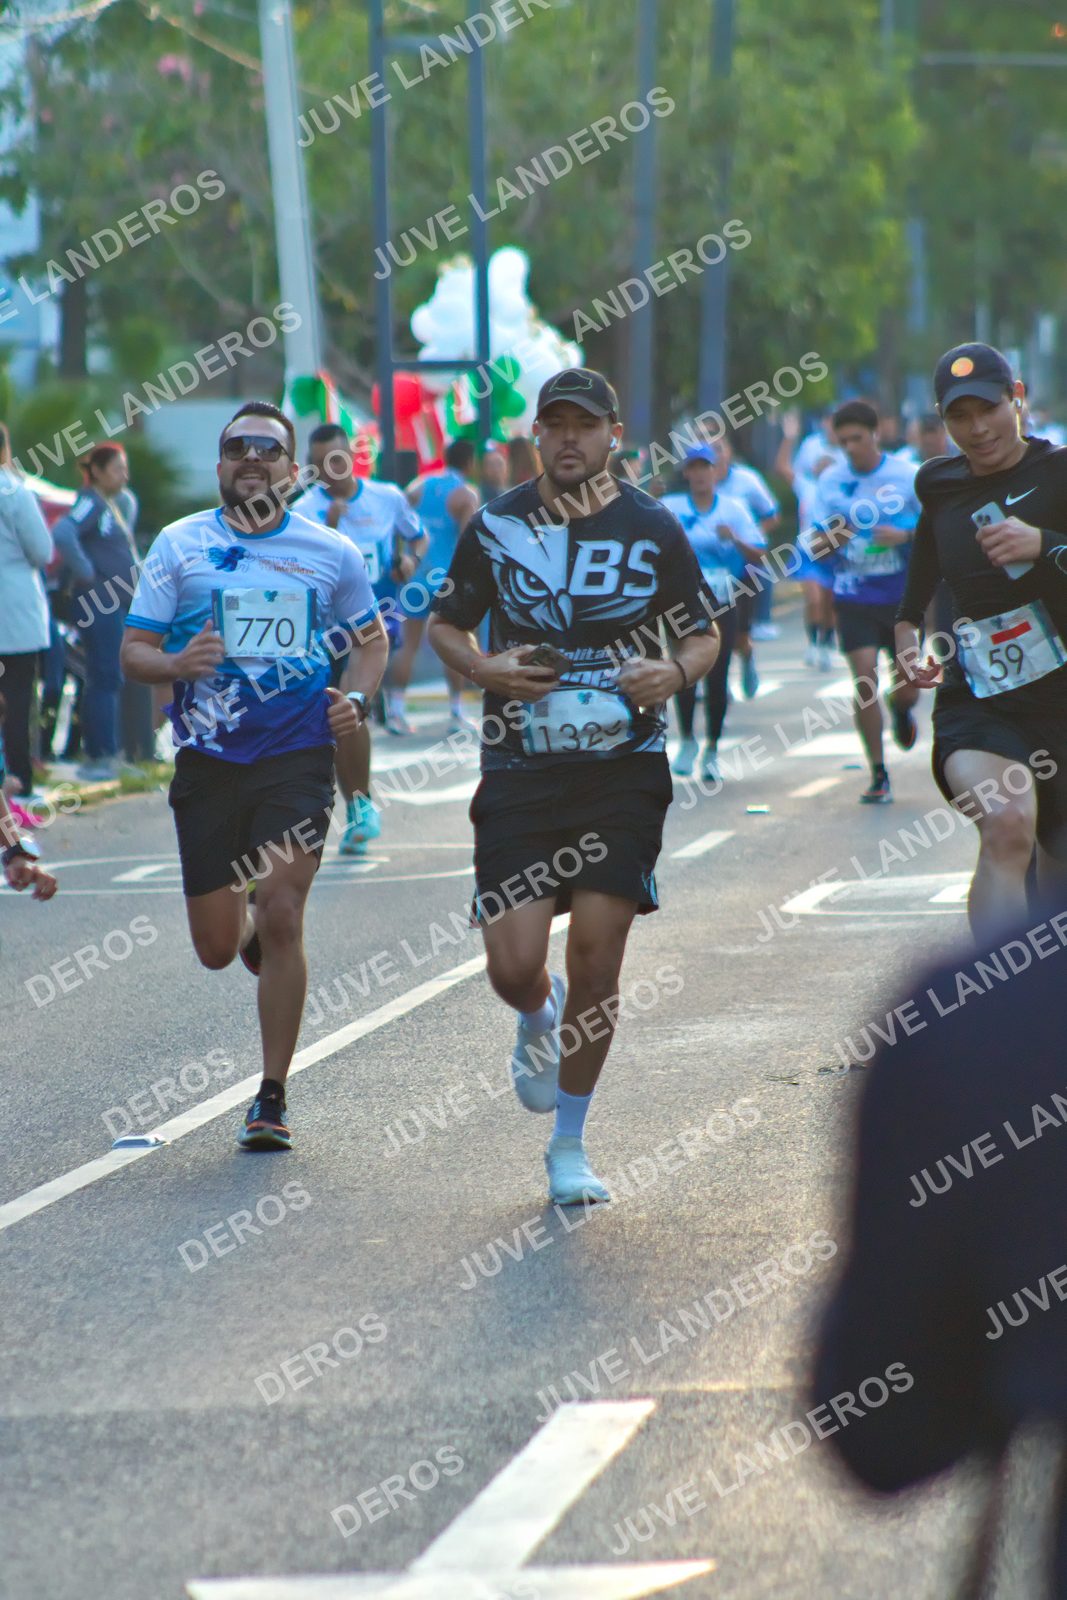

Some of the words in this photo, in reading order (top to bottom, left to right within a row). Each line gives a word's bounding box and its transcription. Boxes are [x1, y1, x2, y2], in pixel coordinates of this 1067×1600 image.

[568, 539, 661, 598] BS
[236, 617, 295, 648] 770
[989, 643, 1024, 681] 59
